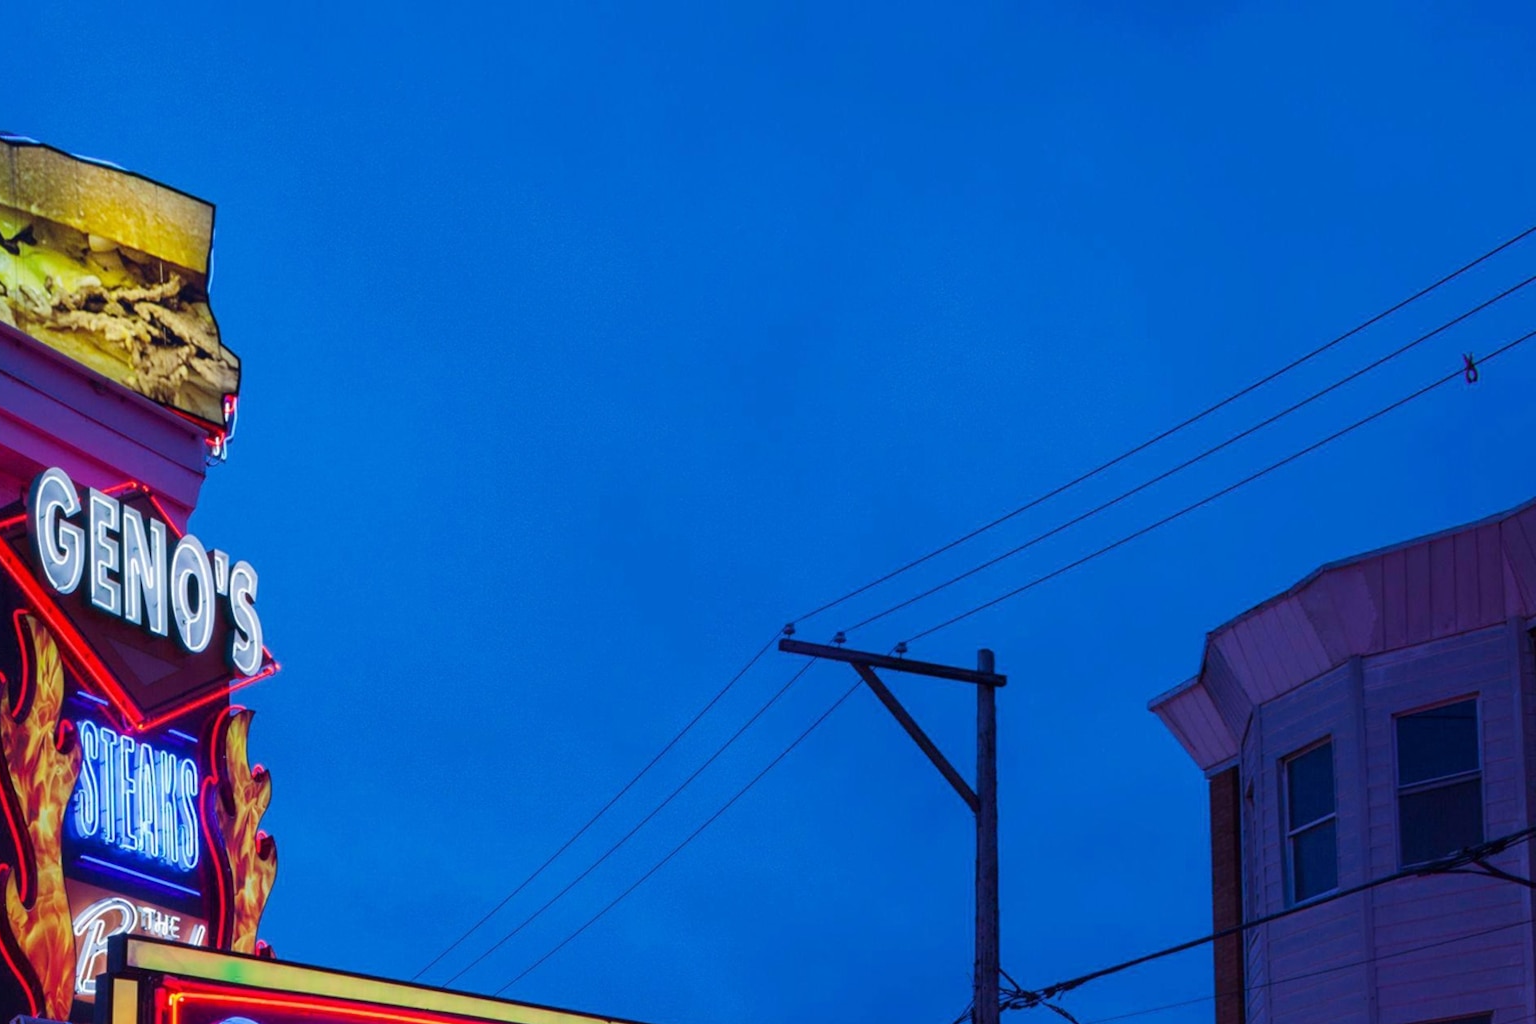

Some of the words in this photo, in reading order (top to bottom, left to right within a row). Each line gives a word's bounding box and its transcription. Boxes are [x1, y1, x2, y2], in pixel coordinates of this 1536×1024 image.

[27, 467, 264, 677] GENO'S
[76, 718, 199, 871] STEAKS
[139, 907, 182, 939] THE
